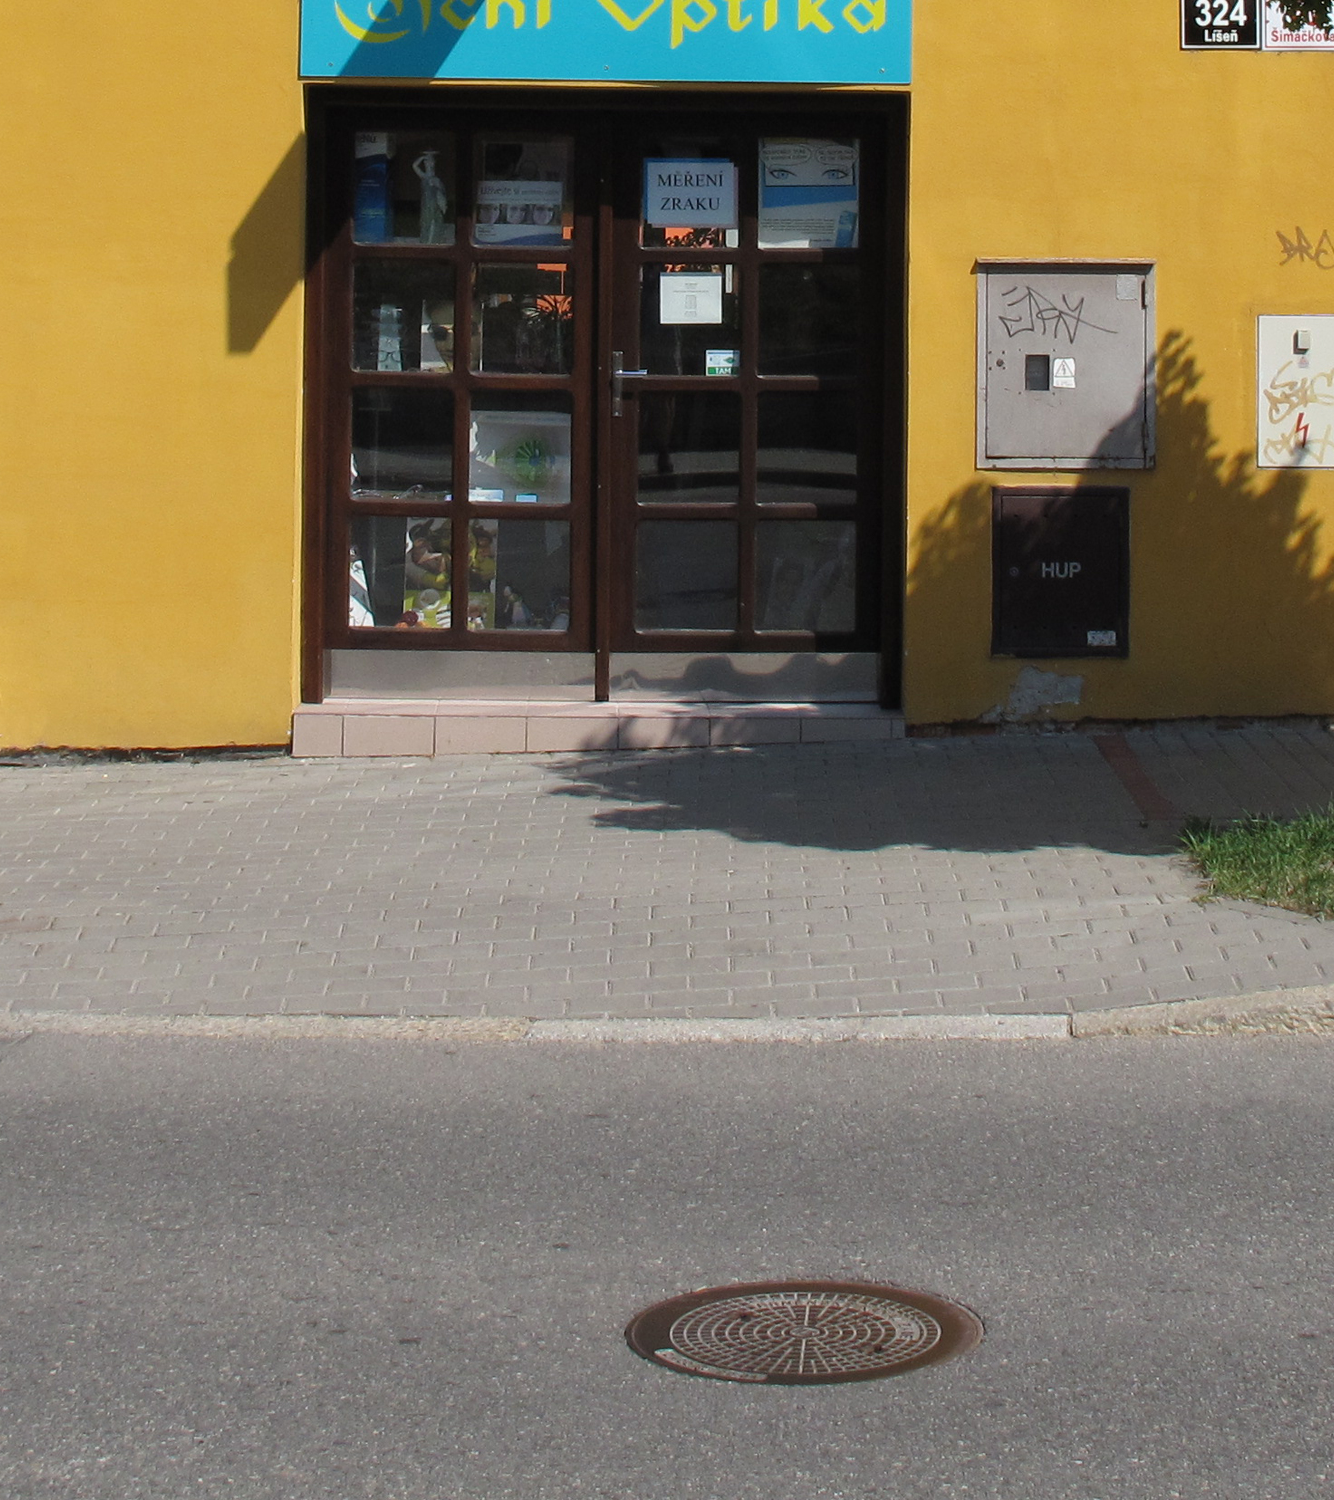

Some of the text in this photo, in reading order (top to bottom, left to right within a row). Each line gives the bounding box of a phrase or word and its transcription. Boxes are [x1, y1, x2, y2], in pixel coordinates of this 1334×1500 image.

[1204, 29, 1238, 42] Líšeň
[658, 171, 724, 187] MĚŘENÍ
[660, 197, 720, 211] ZRAKU
[1042, 562, 1082, 578] HUP
